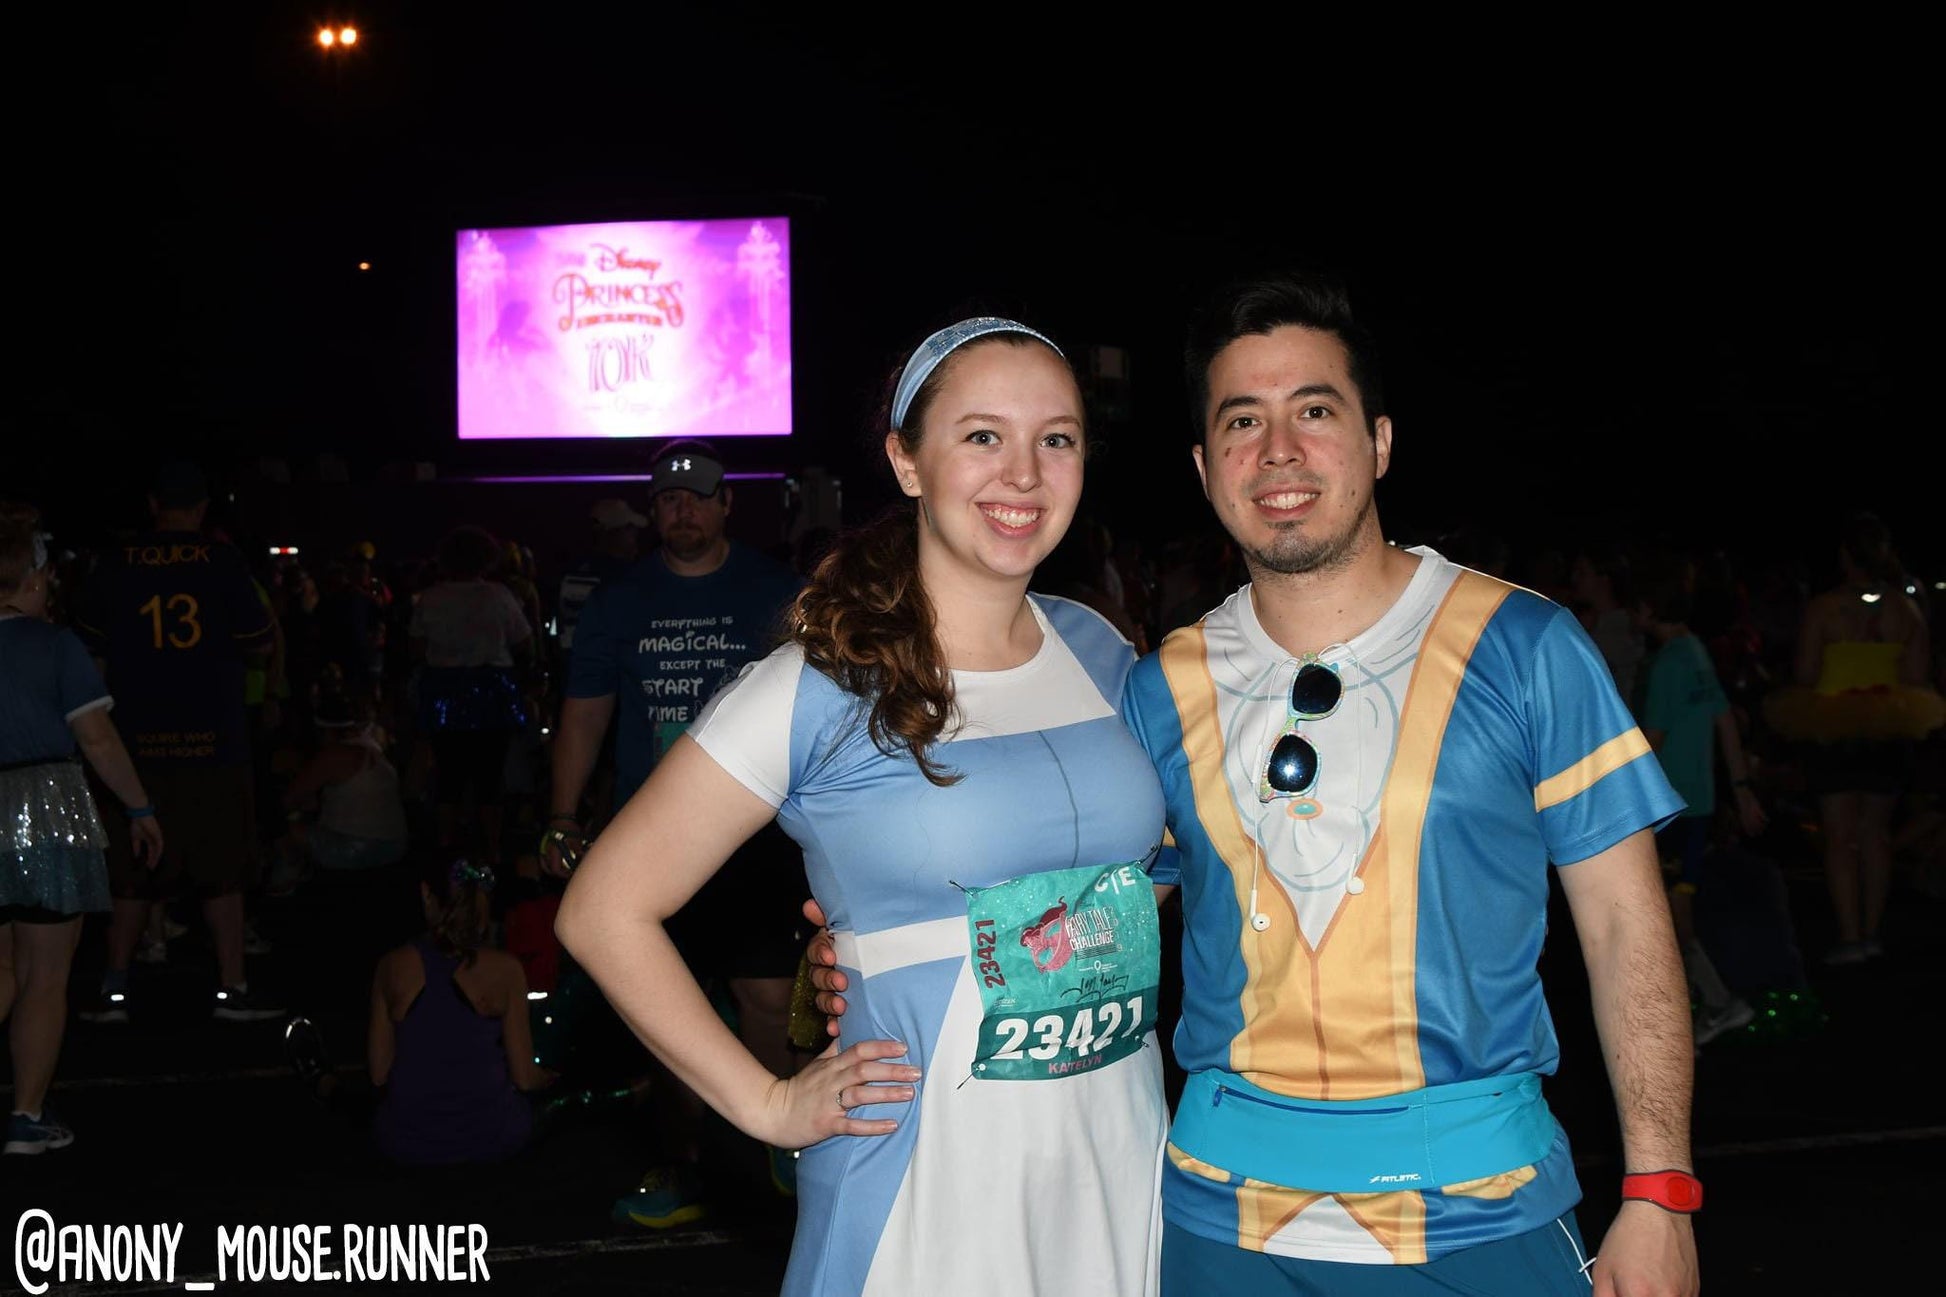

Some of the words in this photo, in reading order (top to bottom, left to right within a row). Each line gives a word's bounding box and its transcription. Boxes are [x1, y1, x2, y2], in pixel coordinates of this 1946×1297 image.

[590, 243, 661, 280] Disney
[552, 273, 685, 331] PRINCESS
[137, 592, 203, 651] 13
[650, 617, 717, 630] EVERYTHING
[721, 616, 734, 625] IS
[659, 660, 700, 670] EXCEPT
[704, 658, 727, 670] THE
[641, 677, 704, 697] START
[648, 705, 689, 722] TIME
[1064, 910, 1091, 940] FAIRY
[1068, 930, 1115, 951] CHALLENGE
[975, 919, 1006, 989] 23421
[989, 996, 1143, 1061] 23421
[1048, 1054, 1103, 1074] KATELYN
